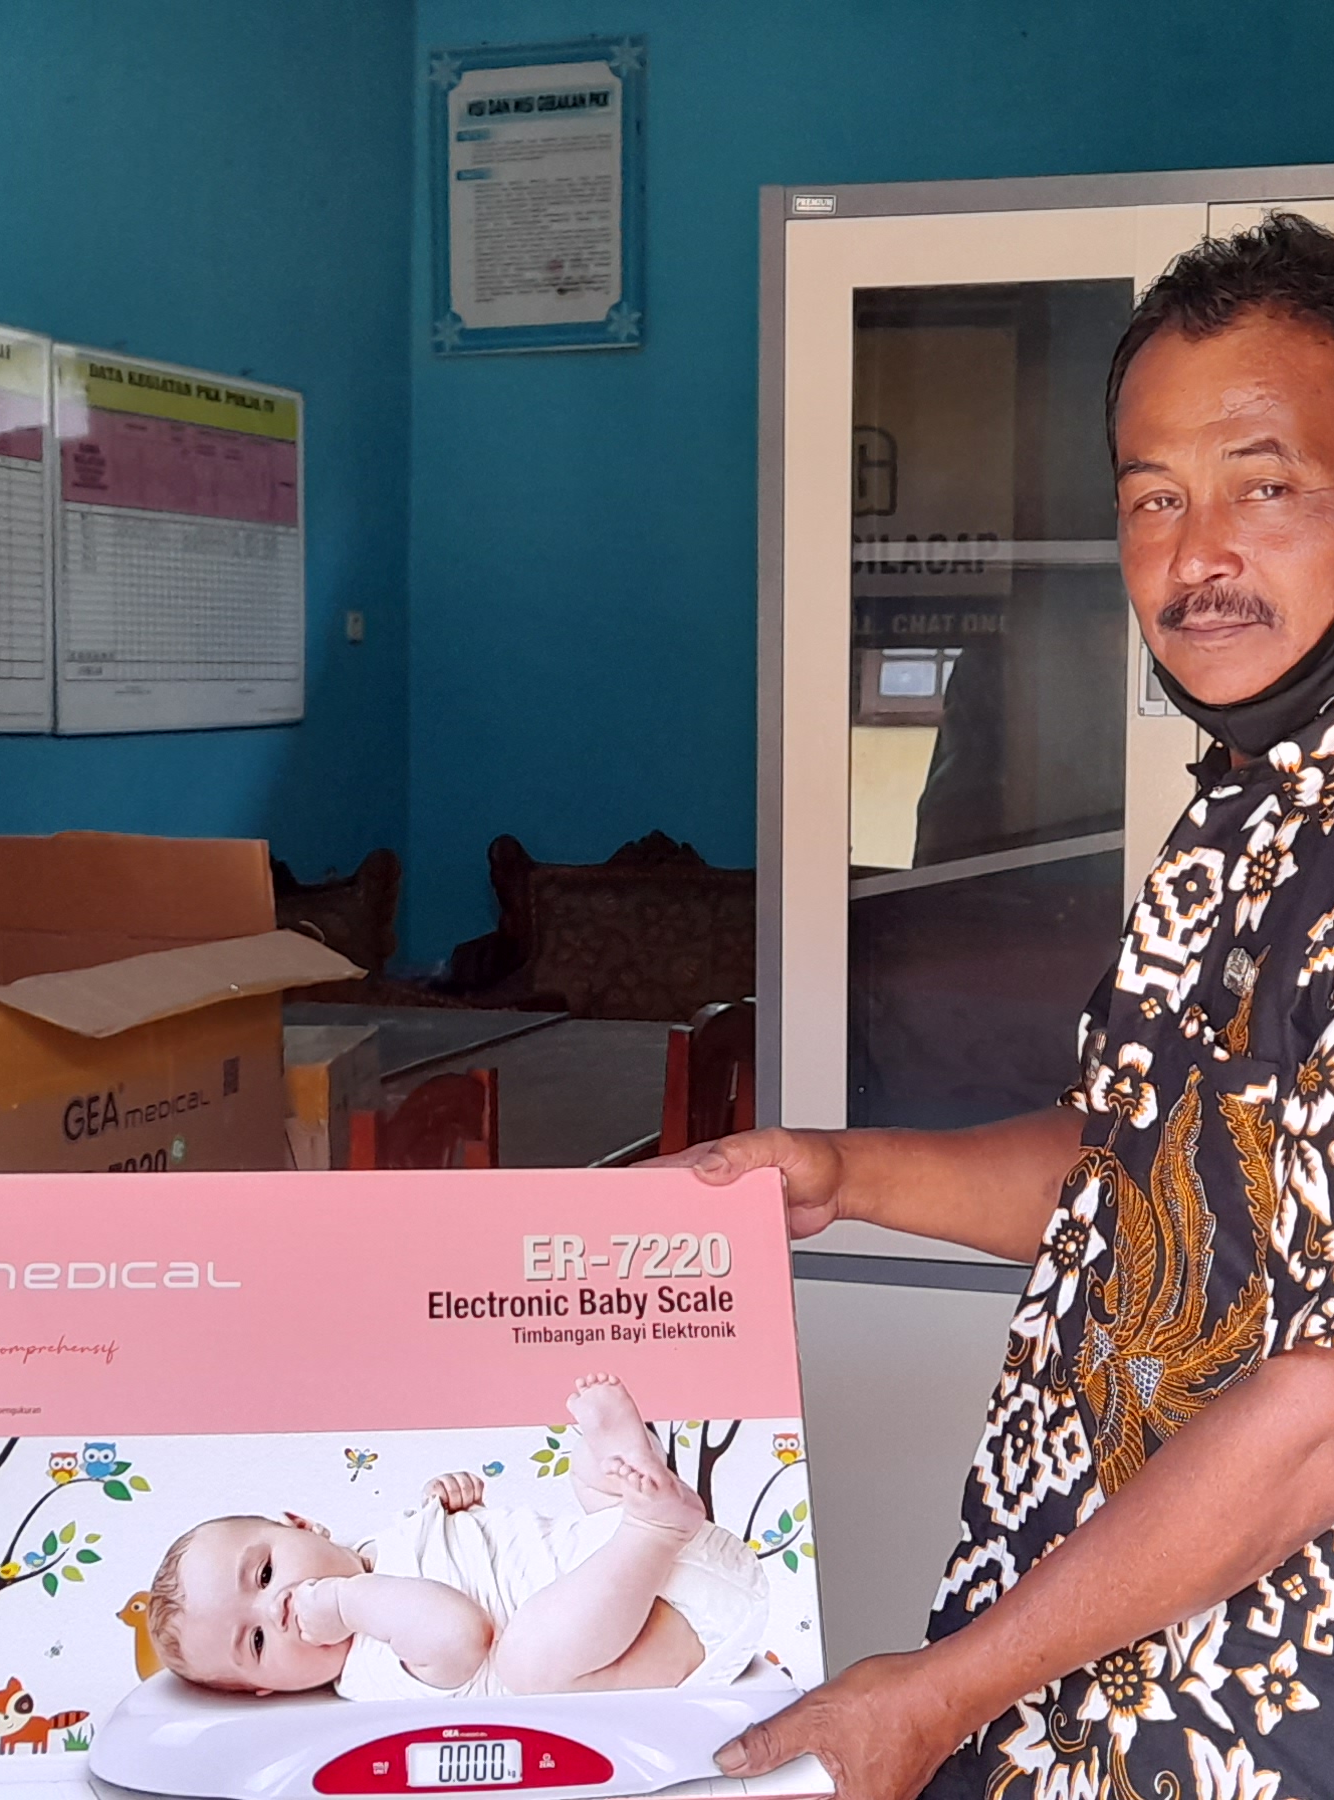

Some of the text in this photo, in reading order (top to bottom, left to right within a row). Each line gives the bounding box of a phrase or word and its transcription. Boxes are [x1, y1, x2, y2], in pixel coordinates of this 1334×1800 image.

[89, 363, 123, 384] DATA
[128, 370, 192, 396] KEGIATAN
[854, 533, 999, 574] ILACAP
[63, 1091, 119, 1140] GEA
[522, 1232, 733, 1282] ER-7220
[428, 1285, 734, 1320] Electronic Baby Scale
[512, 1321, 737, 1346] Timbangan Bayi Elektronik
[439, 1743, 505, 1783] 0.000
